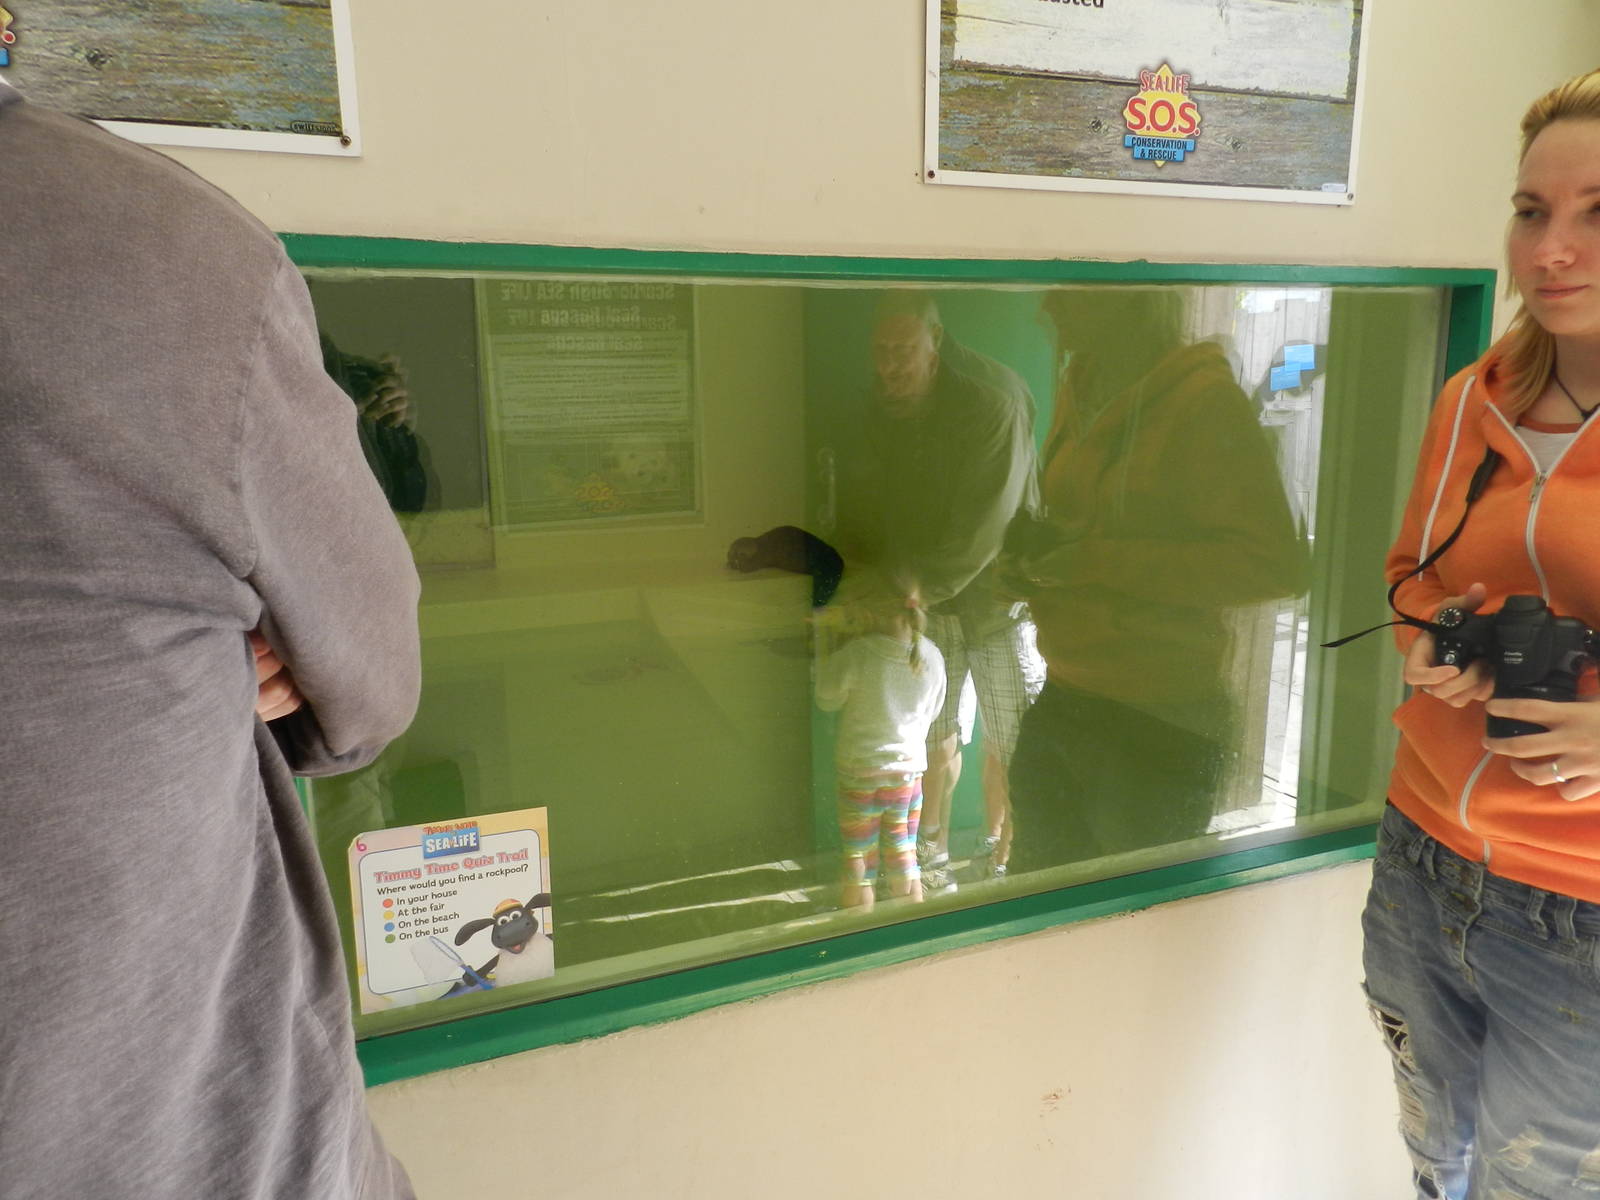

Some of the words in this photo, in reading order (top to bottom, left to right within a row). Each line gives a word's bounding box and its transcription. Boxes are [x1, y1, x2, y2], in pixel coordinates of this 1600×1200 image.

[1131, 137, 1187, 150] CONSERVATION
[1140, 149, 1146, 157] &
[1148, 149, 1177, 160] RESCUE
[356, 838, 368, 852] 6
[426, 837, 450, 853] SEA
[374, 868, 422, 883] Timmy
[424, 863, 460, 875] Time
[463, 855, 494, 869] Quiz
[496, 848, 528, 863] Trail
[377, 885, 407, 895] Where
[409, 880, 436, 890] would
[438, 877, 456, 887] you
[458, 873, 476, 882] find
[486, 863, 529, 877] rockpool?
[407, 894, 429, 905] your
[431, 889, 458, 899] house
[397, 908, 409, 917] At
[412, 907, 427, 915] the
[430, 903, 445, 912] fair
[398, 920, 412, 929] On
[414, 918, 429, 926] the
[432, 911, 460, 923] beach
[399, 932, 412, 940] On
[415, 929, 430, 938] the
[433, 926, 449, 935] bus
